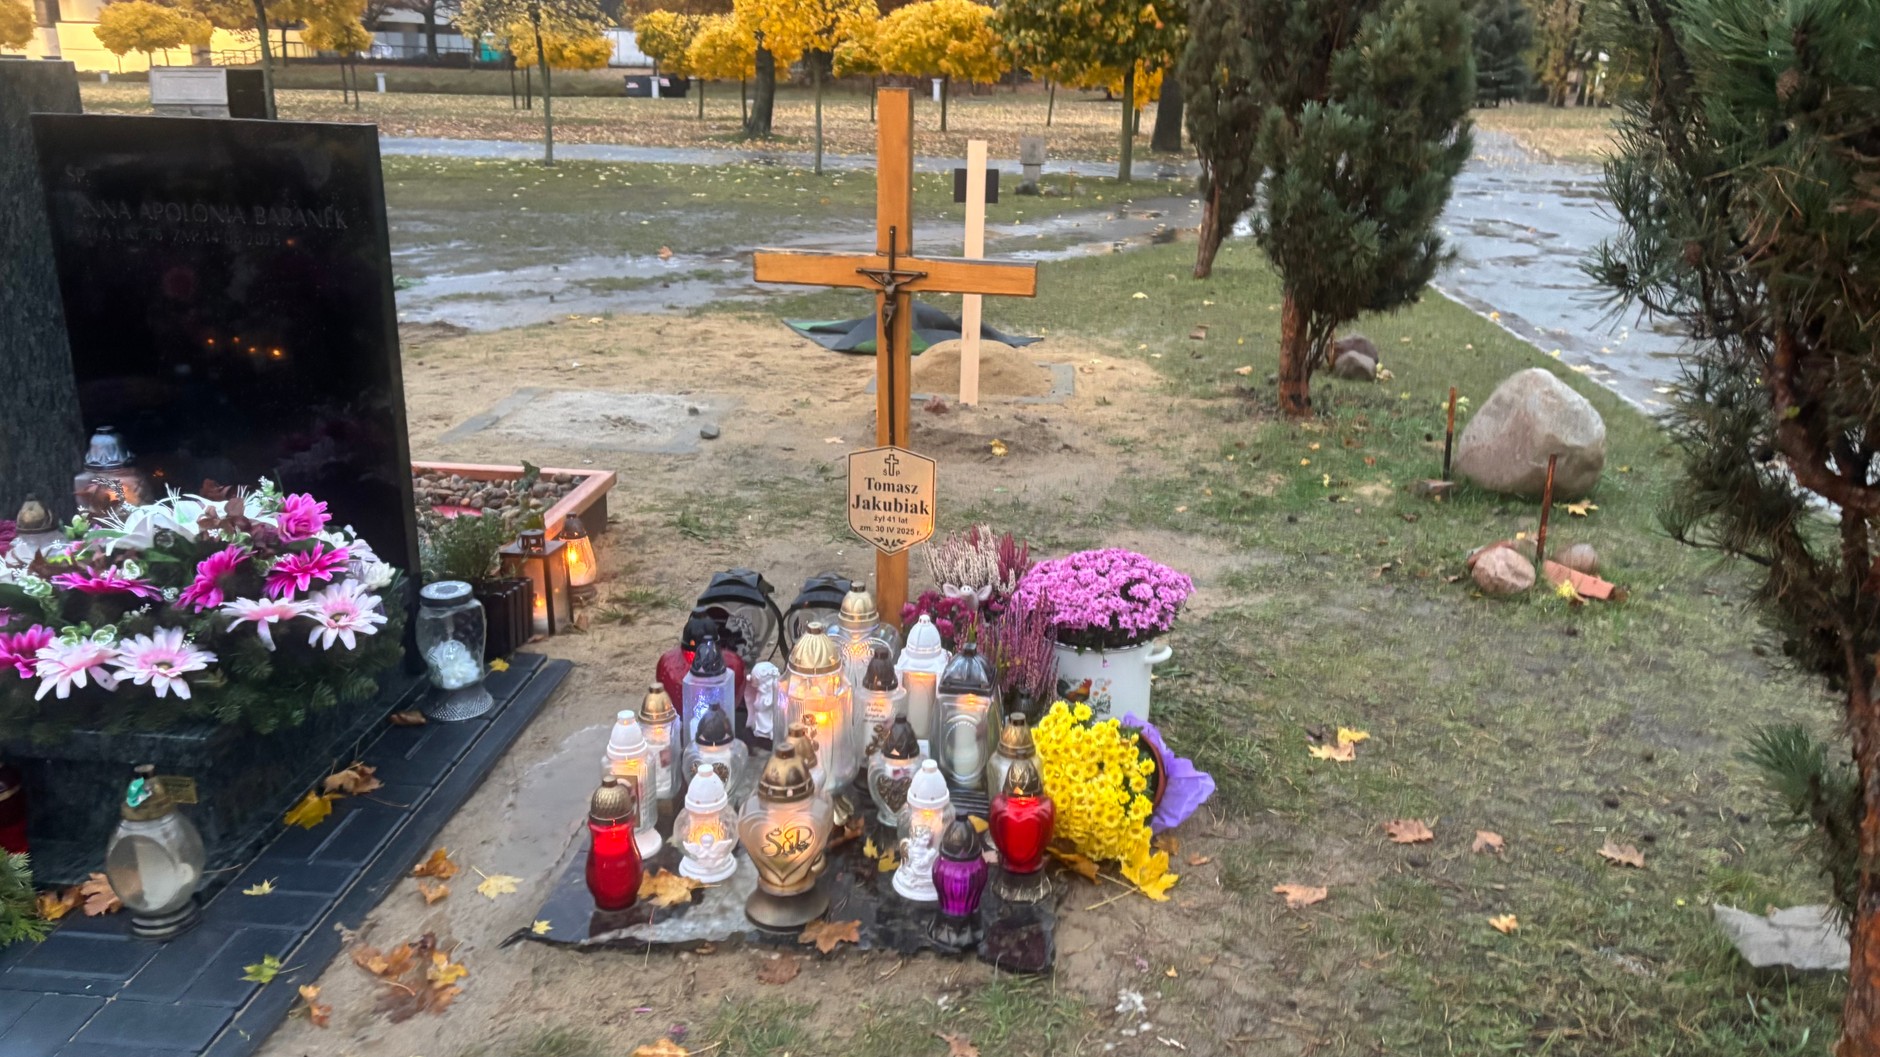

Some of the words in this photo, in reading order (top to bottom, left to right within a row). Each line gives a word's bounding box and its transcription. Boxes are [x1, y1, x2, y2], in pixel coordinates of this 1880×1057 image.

[74, 199, 132, 220] ANNA
[140, 201, 247, 225] APOLONIA
[253, 205, 349, 230] BARANEK
[864, 477, 919, 495] Tomasz
[851, 494, 930, 515] Jakubiak
[874, 515, 885, 524] żył
[887, 515, 896, 523] 41
[898, 516, 908, 524] lat
[875, 525, 885, 533] 30
[886, 526, 895, 534] IV
[896, 526, 915, 535] 2025
